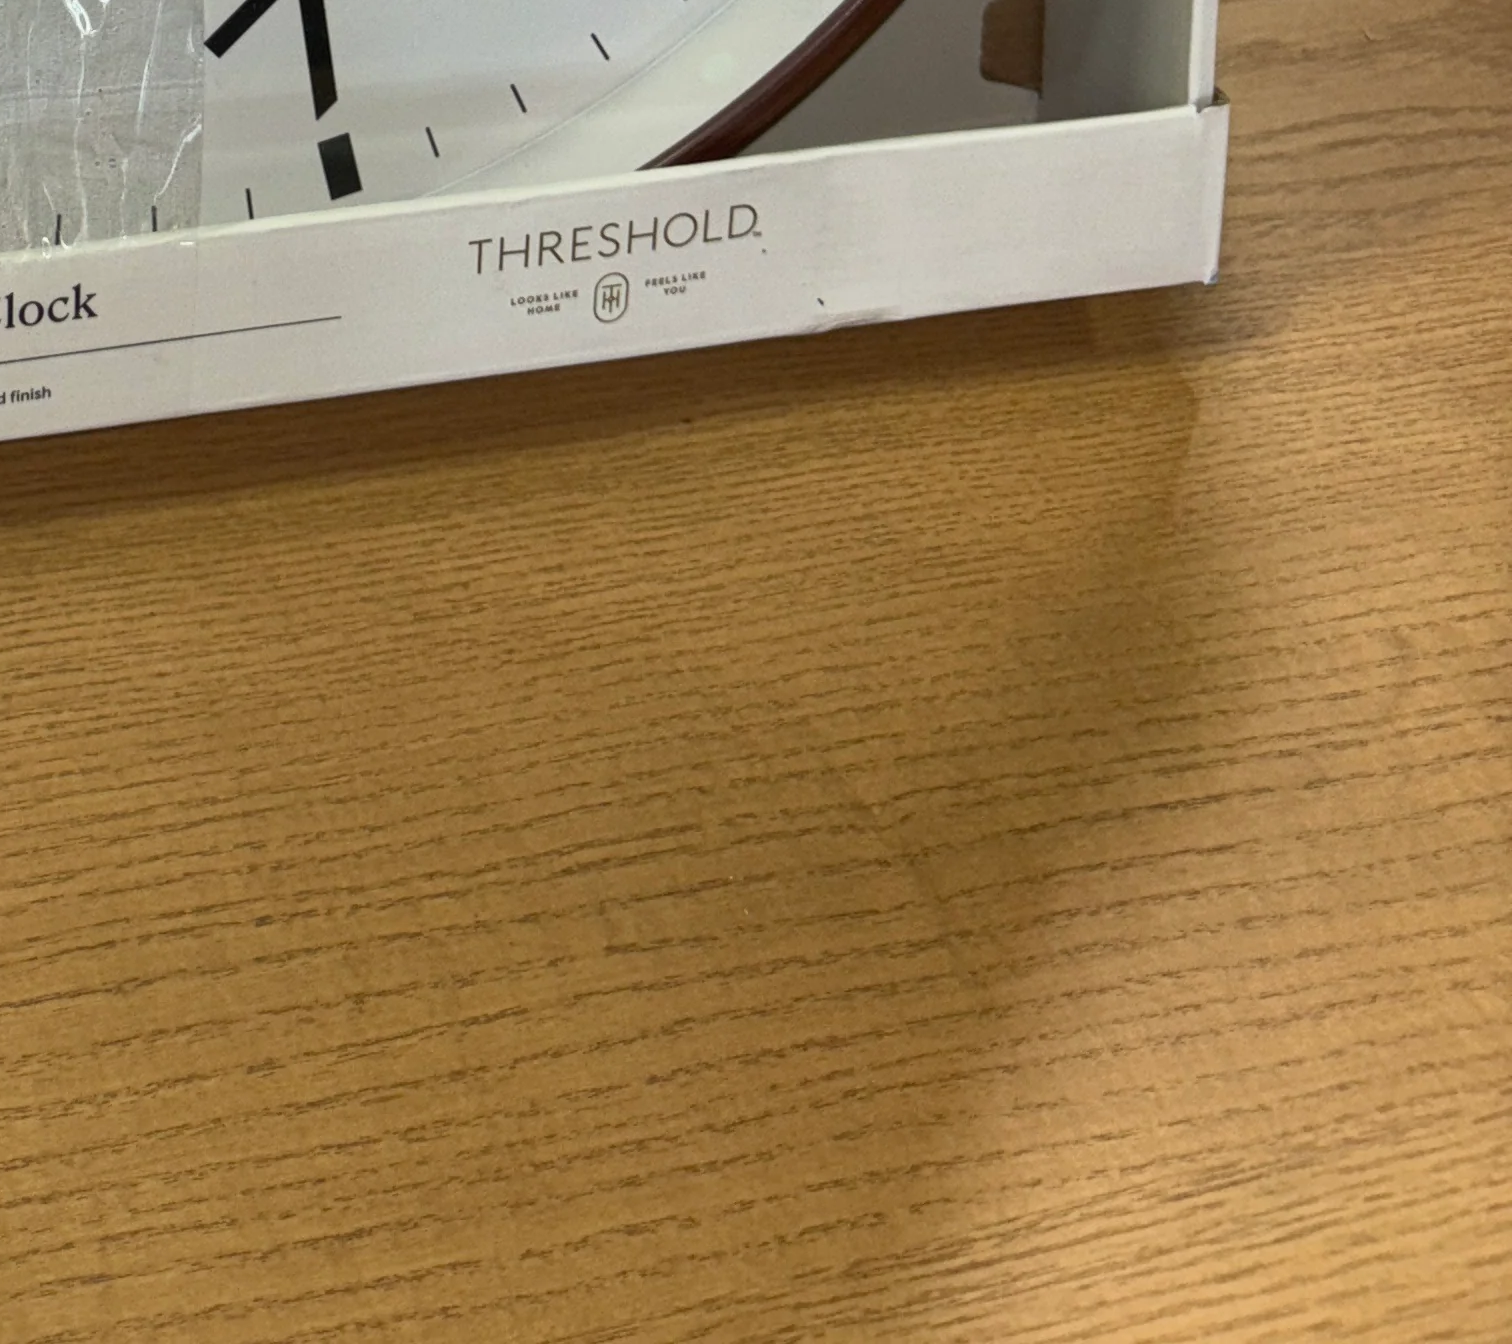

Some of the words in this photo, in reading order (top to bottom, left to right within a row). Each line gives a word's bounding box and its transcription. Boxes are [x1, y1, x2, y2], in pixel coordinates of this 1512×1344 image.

[468, 203, 758, 275] THRESHOLD
[644, 274, 678, 288] FEELS
[681, 270, 707, 282] LIKE
[510, 293, 550, 307] LOOKS
[553, 289, 579, 301] LIKE
[663, 285, 687, 296] YOU
[527, 303, 561, 316] HOME
[10, 386, 52, 404] finish
